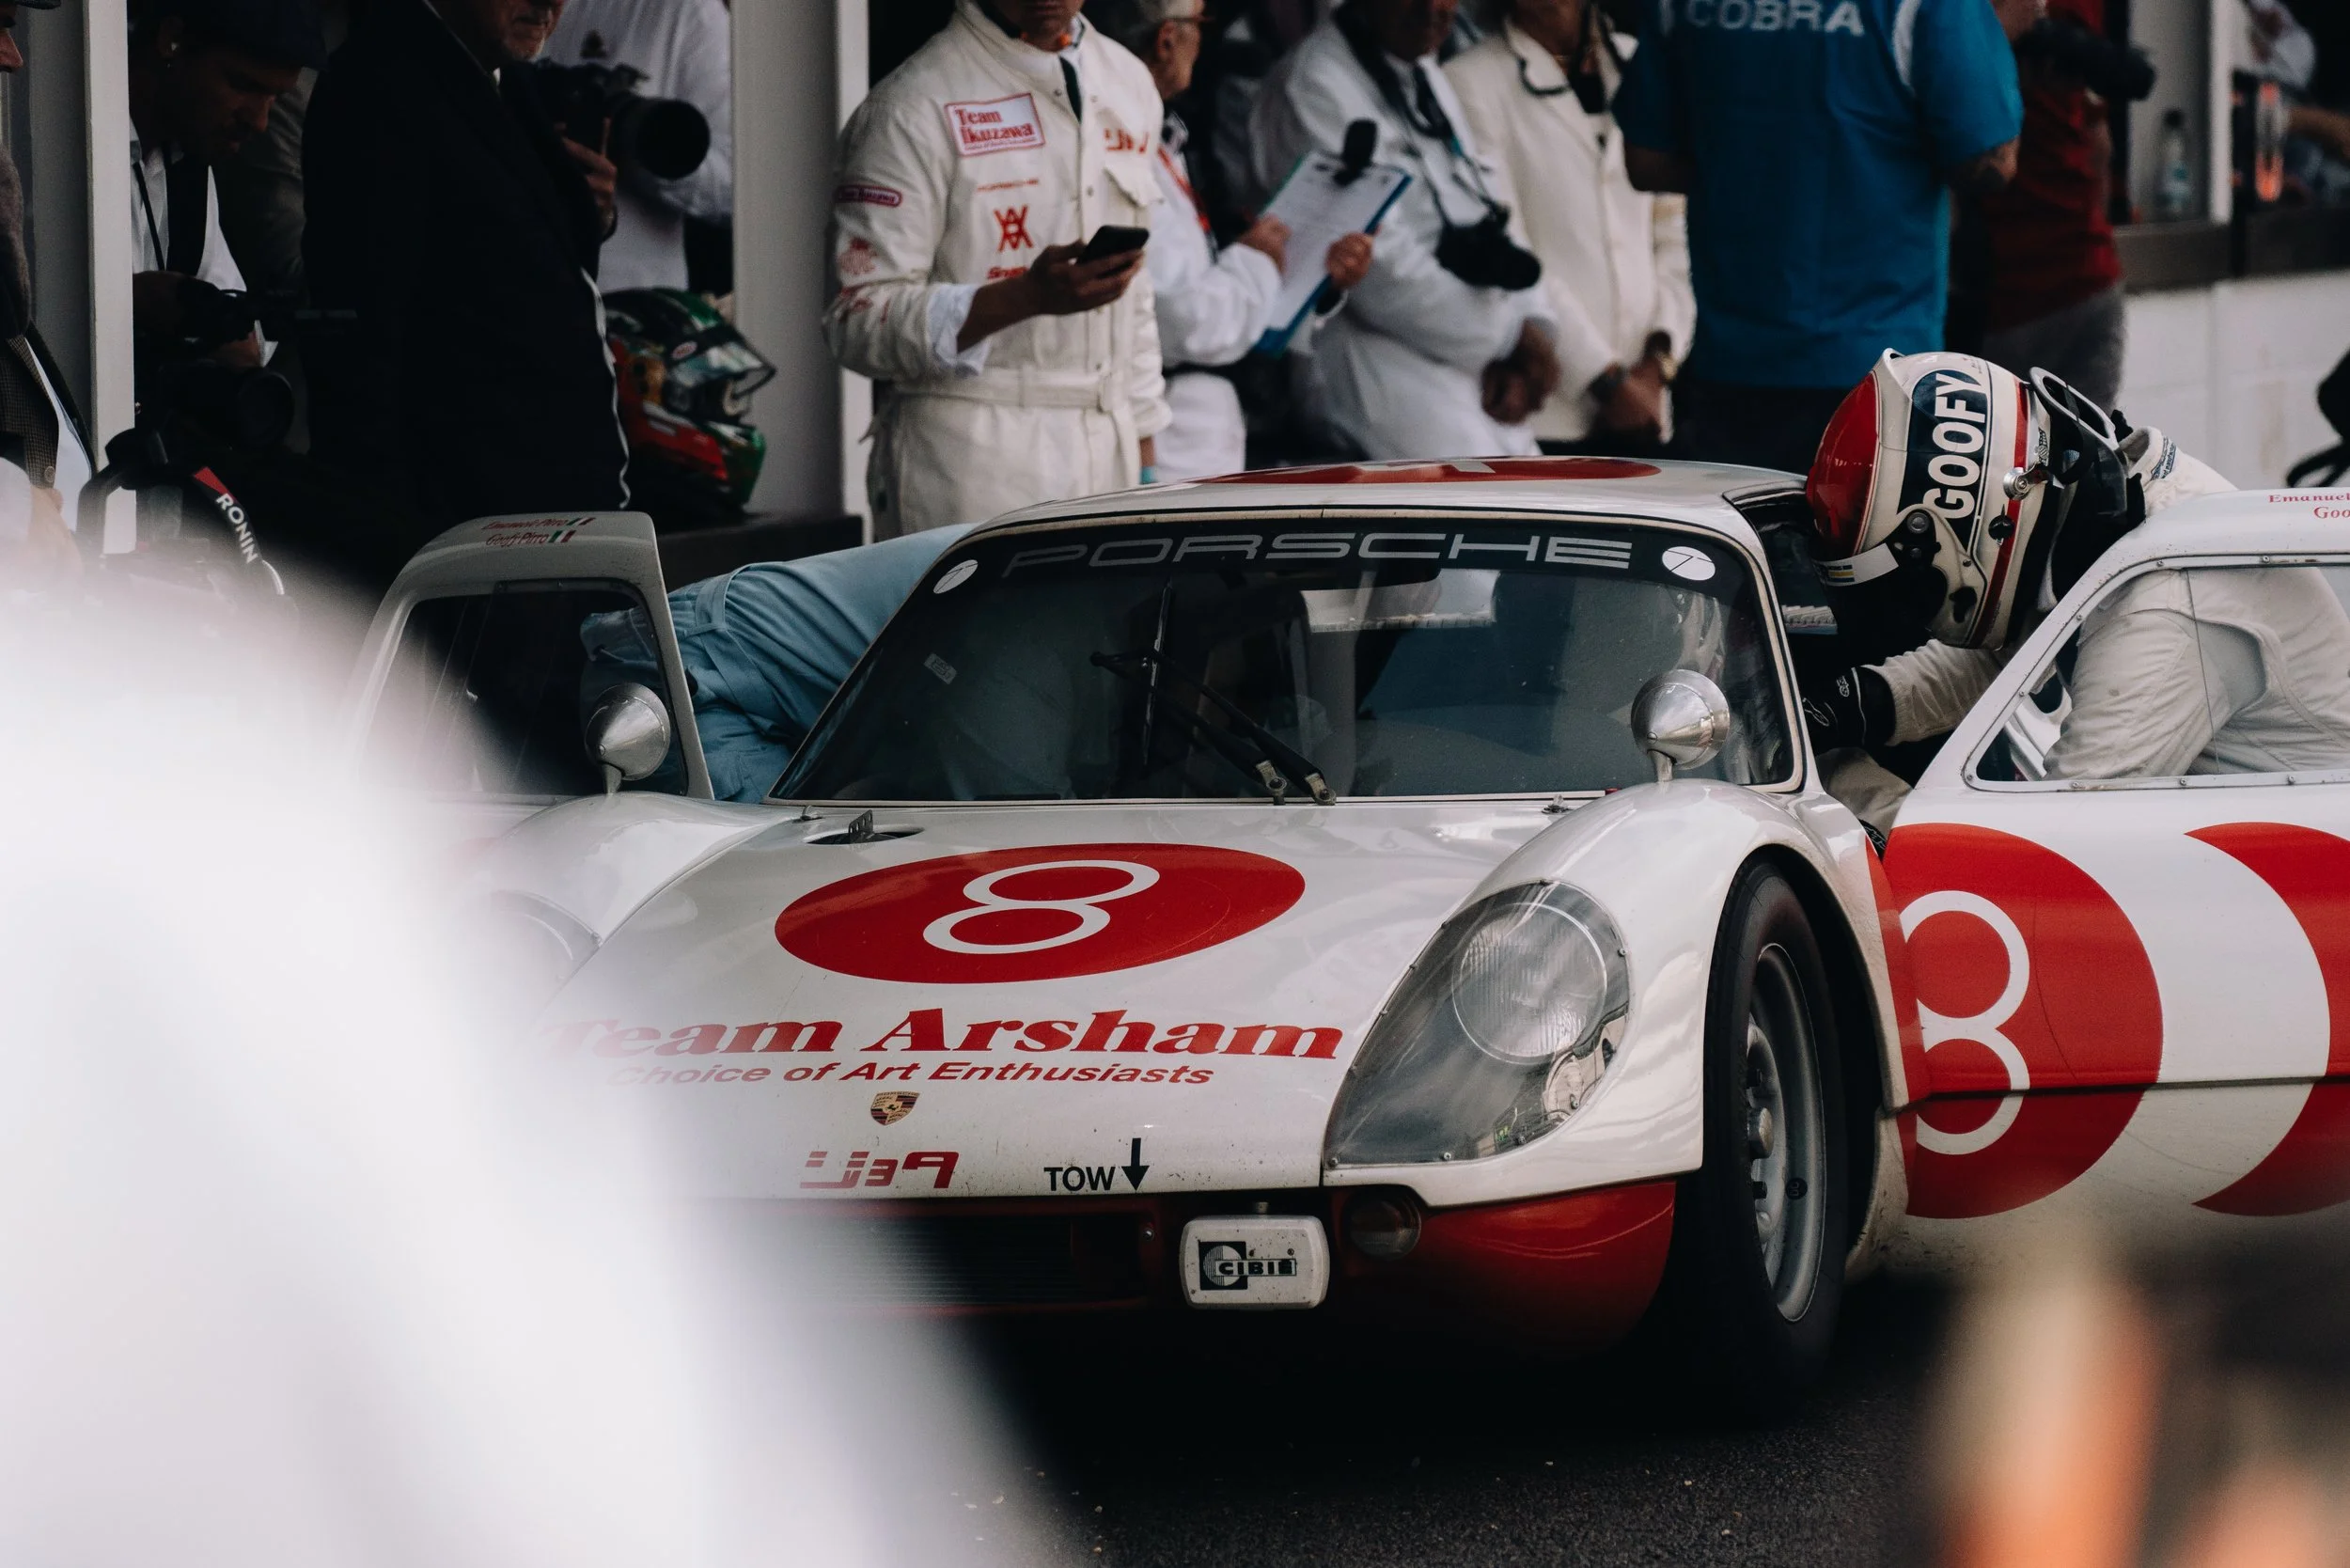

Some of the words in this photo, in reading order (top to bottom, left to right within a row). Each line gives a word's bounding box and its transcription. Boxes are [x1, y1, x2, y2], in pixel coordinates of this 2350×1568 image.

[1688, 0, 1856, 36] COBRA
[955, 108, 1004, 126] Team
[1922, 372, 1989, 520] GOOFY
[216, 493, 258, 563] RONIN
[1001, 532, 1633, 577] PORSCHE
[922, 859, 1160, 954] 8
[541, 1019, 843, 1058] Team
[859, 1008, 1343, 1059] Arsham
[1899, 889, 2030, 1155] 8
[607, 1064, 771, 1086] Choice
[783, 1062, 841, 1081] of
[838, 1062, 922, 1081] Art
[928, 1061, 1215, 1085] Enthusiasts
[1043, 1166, 1117, 1192] TOW
